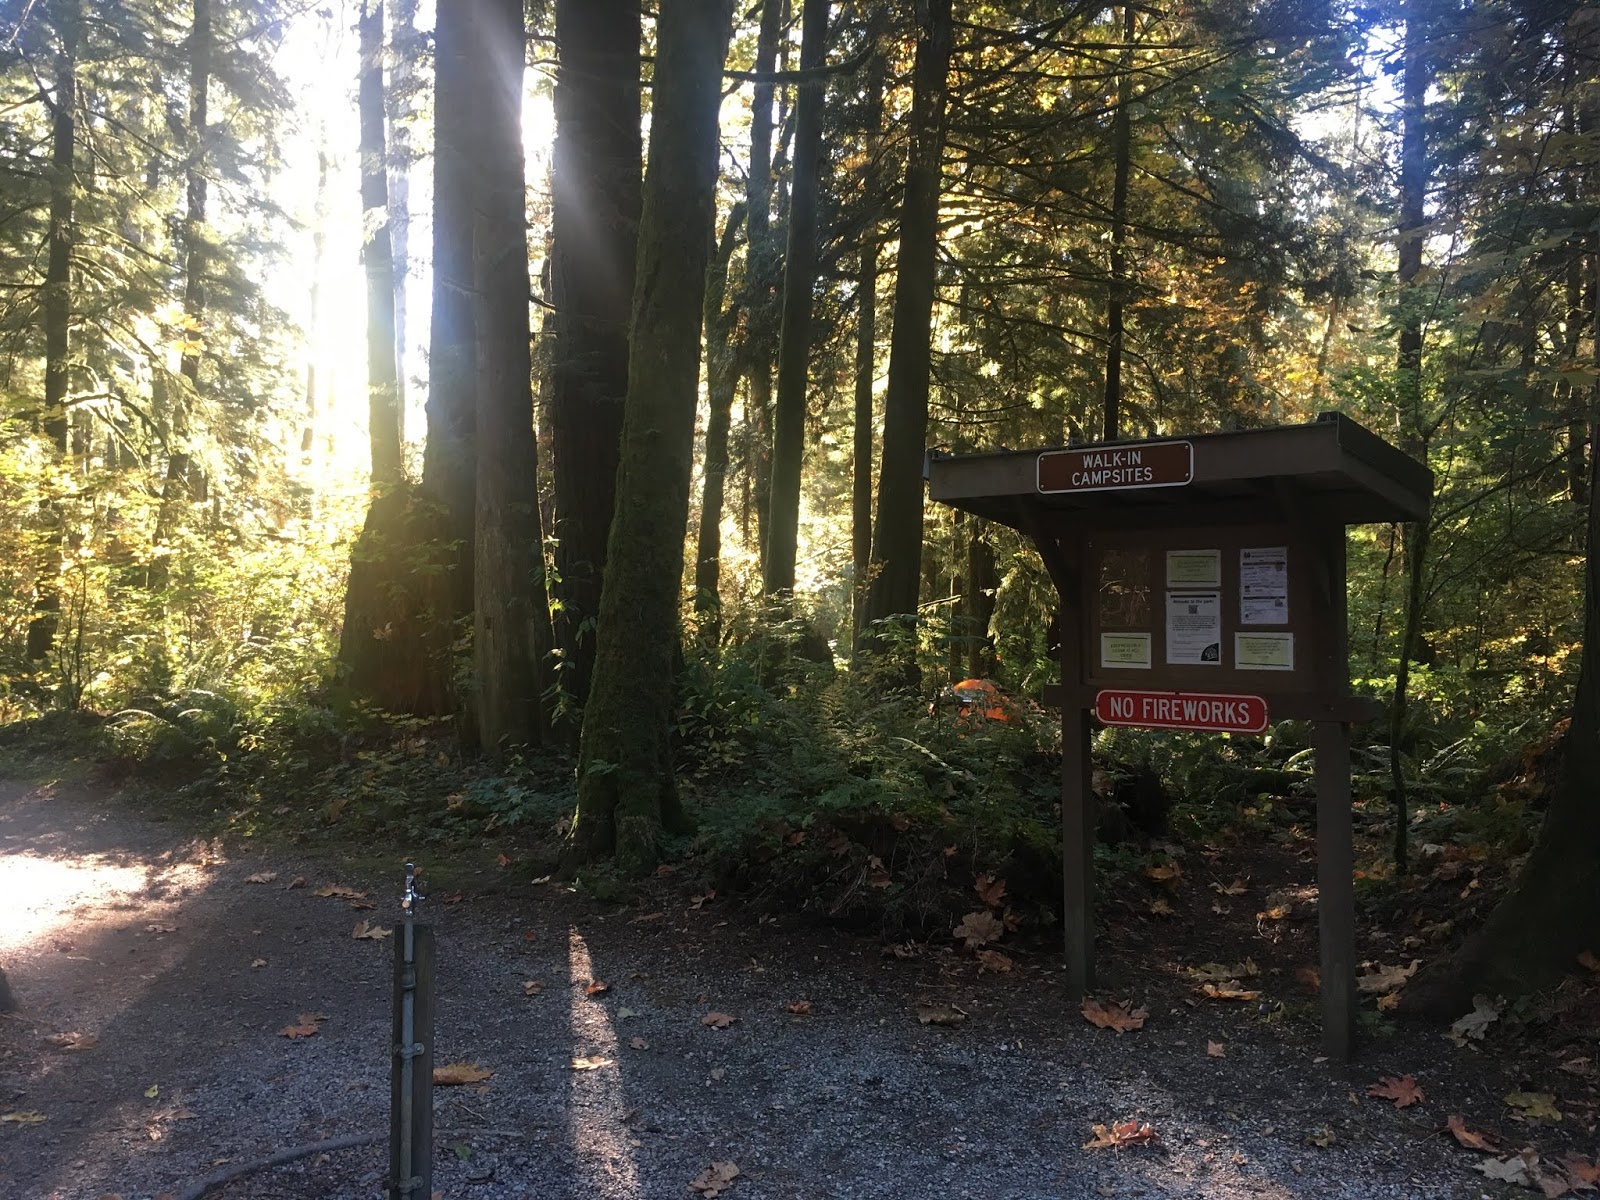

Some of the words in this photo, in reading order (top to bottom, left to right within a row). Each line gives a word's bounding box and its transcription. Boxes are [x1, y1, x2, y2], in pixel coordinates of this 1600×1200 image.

[1083, 450, 1141, 469] WALK-IN
[1072, 467, 1153, 486] CAMPSITES
[1110, 697, 1134, 718] NO
[1143, 698, 1250, 725] FIREWORKS
